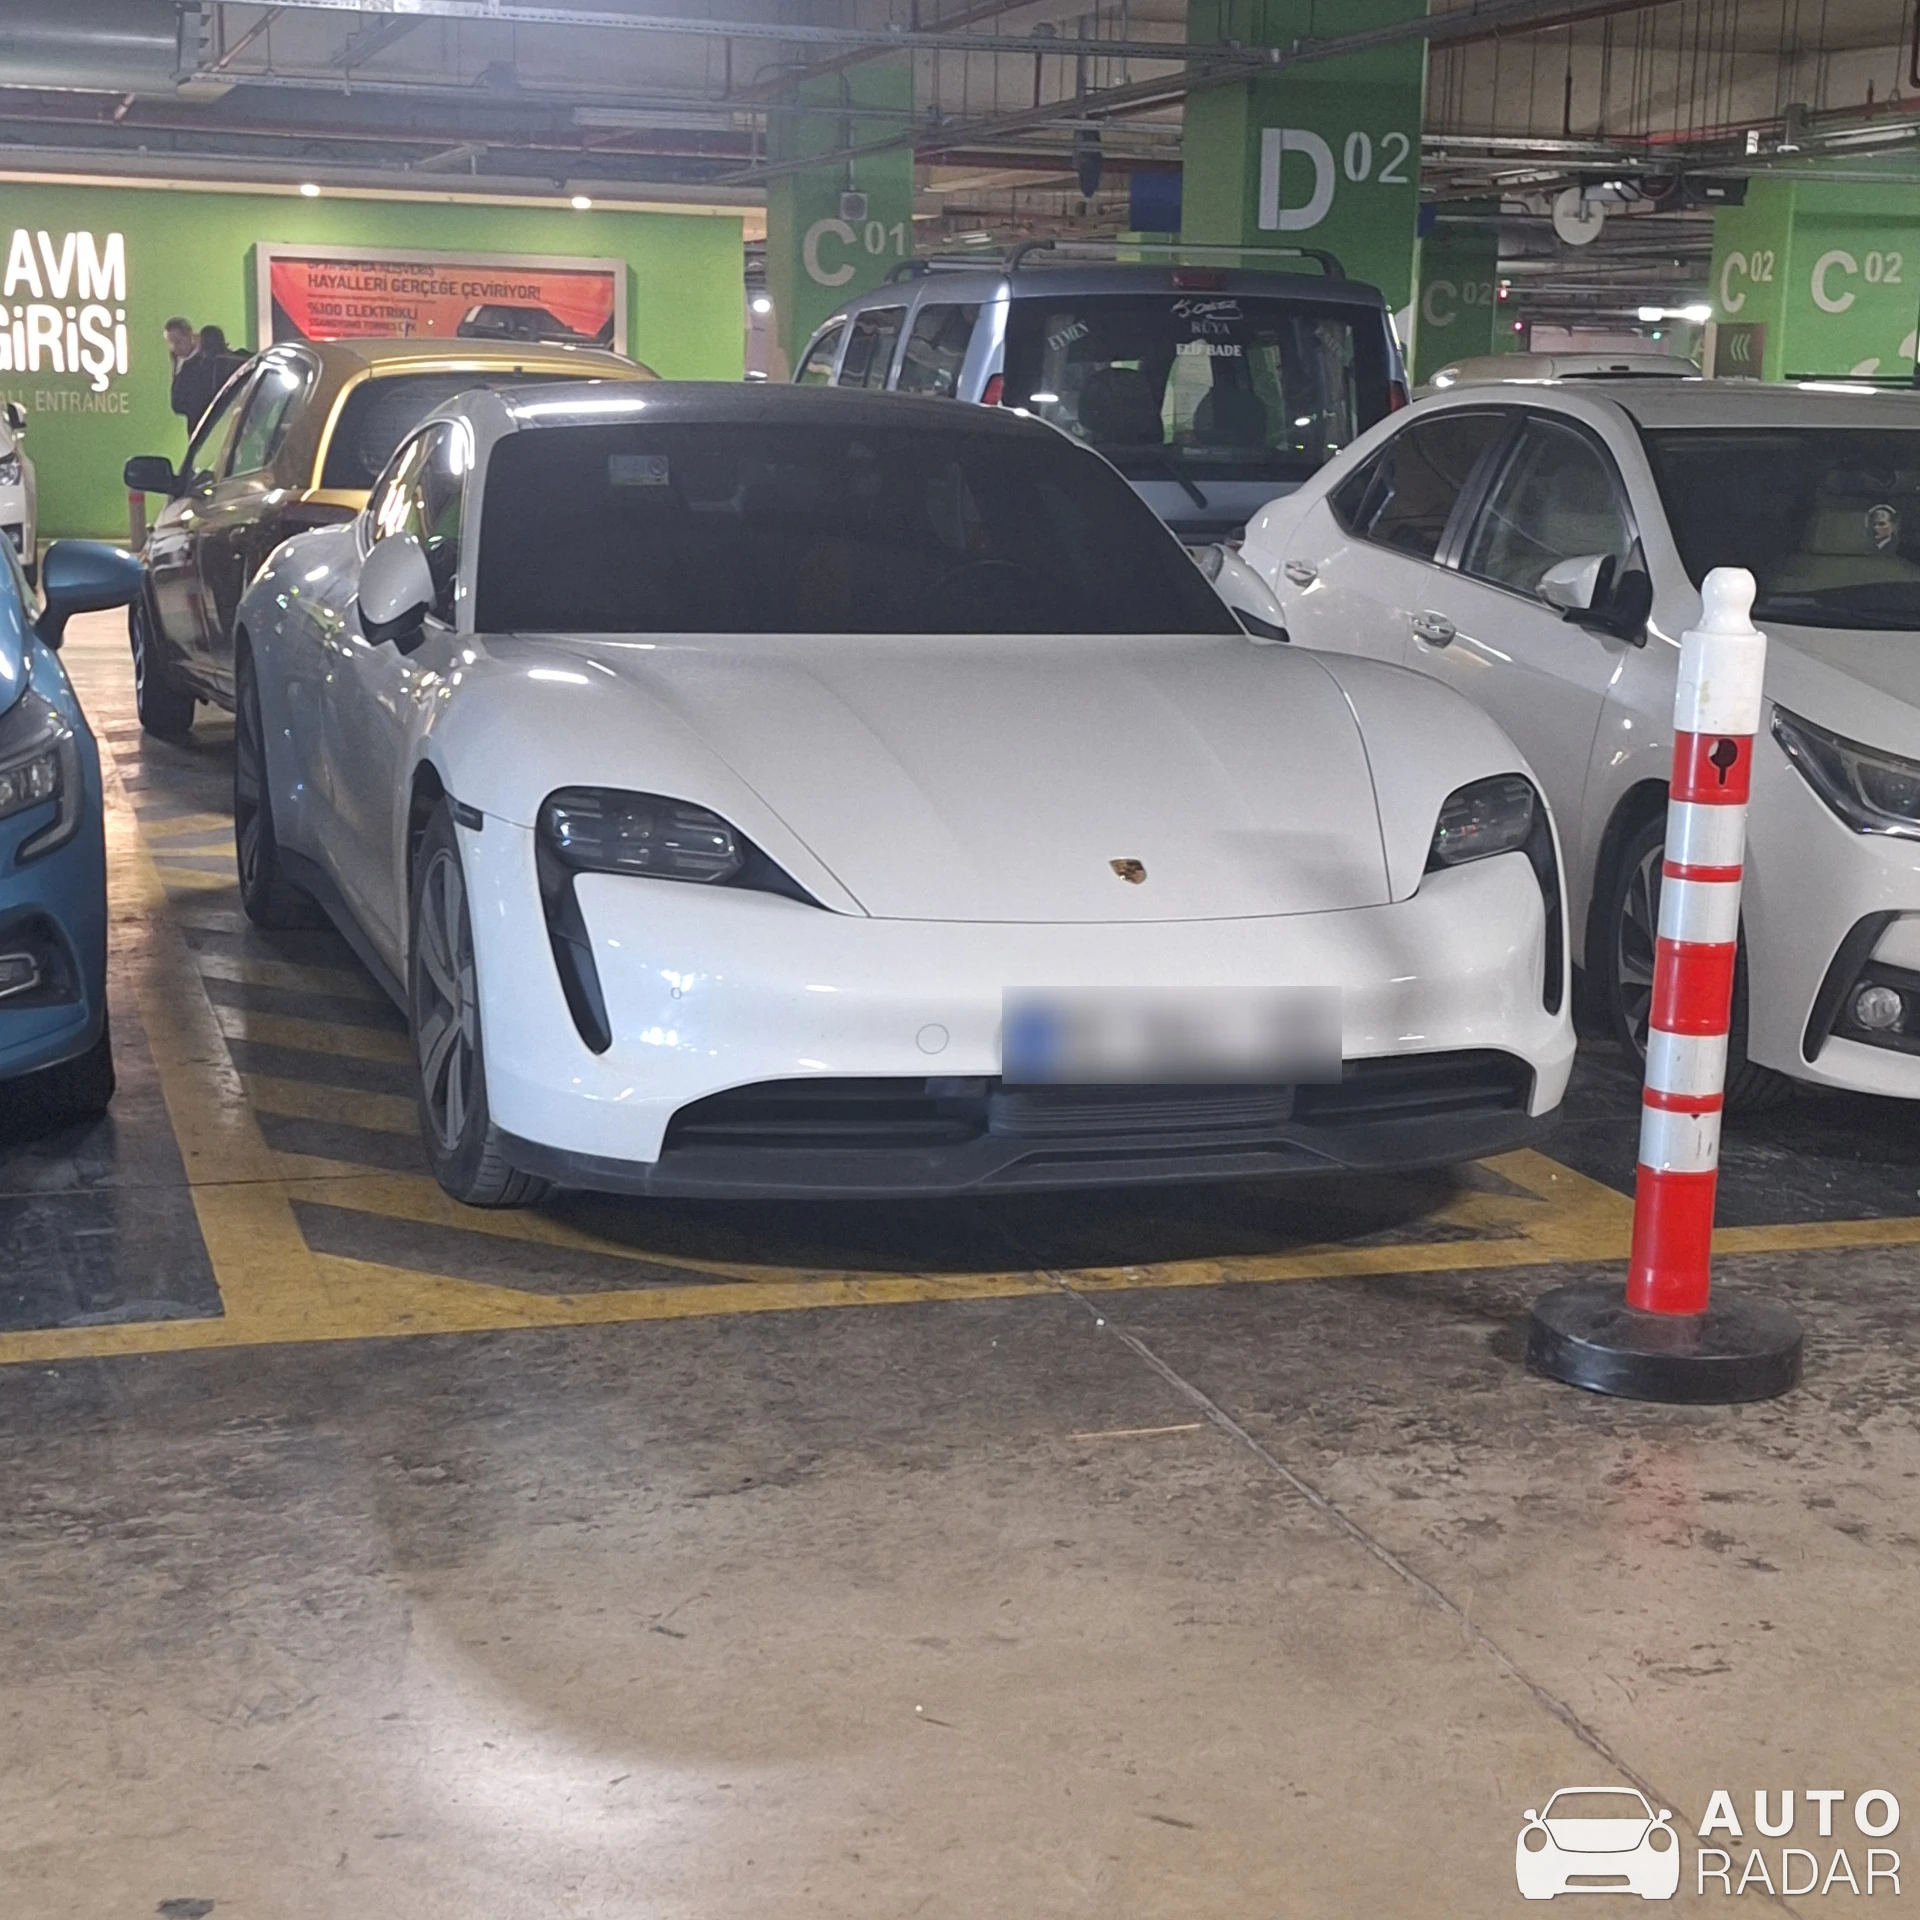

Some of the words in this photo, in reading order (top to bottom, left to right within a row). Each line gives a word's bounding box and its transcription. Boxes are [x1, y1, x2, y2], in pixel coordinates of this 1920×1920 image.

[3, 229, 126, 302] AVM
[307, 273, 388, 292] HAYALLERİ
[1207, 343, 1243, 357] BADE
[34, 389, 130, 414] ENTRANCE
